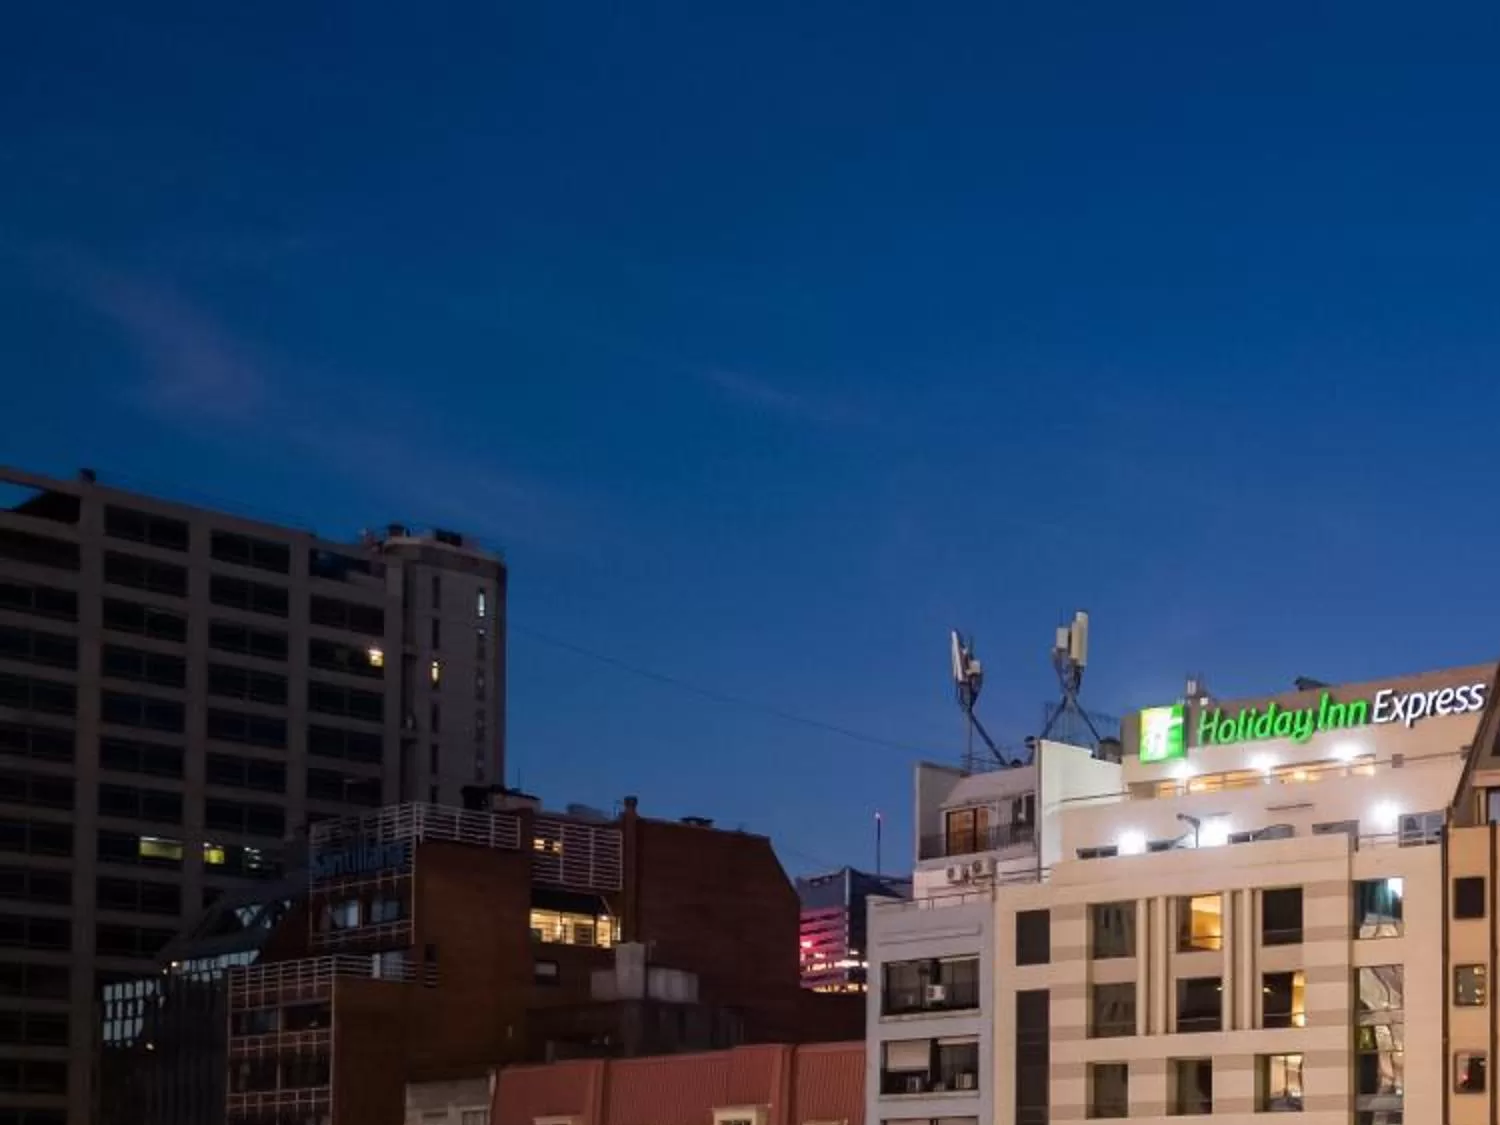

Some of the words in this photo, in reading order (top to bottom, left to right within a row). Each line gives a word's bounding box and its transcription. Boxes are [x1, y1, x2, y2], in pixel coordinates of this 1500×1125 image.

[1197, 702, 1314, 745] Holiday
[1318, 691, 1368, 731] Inn
[1372, 682, 1485, 728] Express
